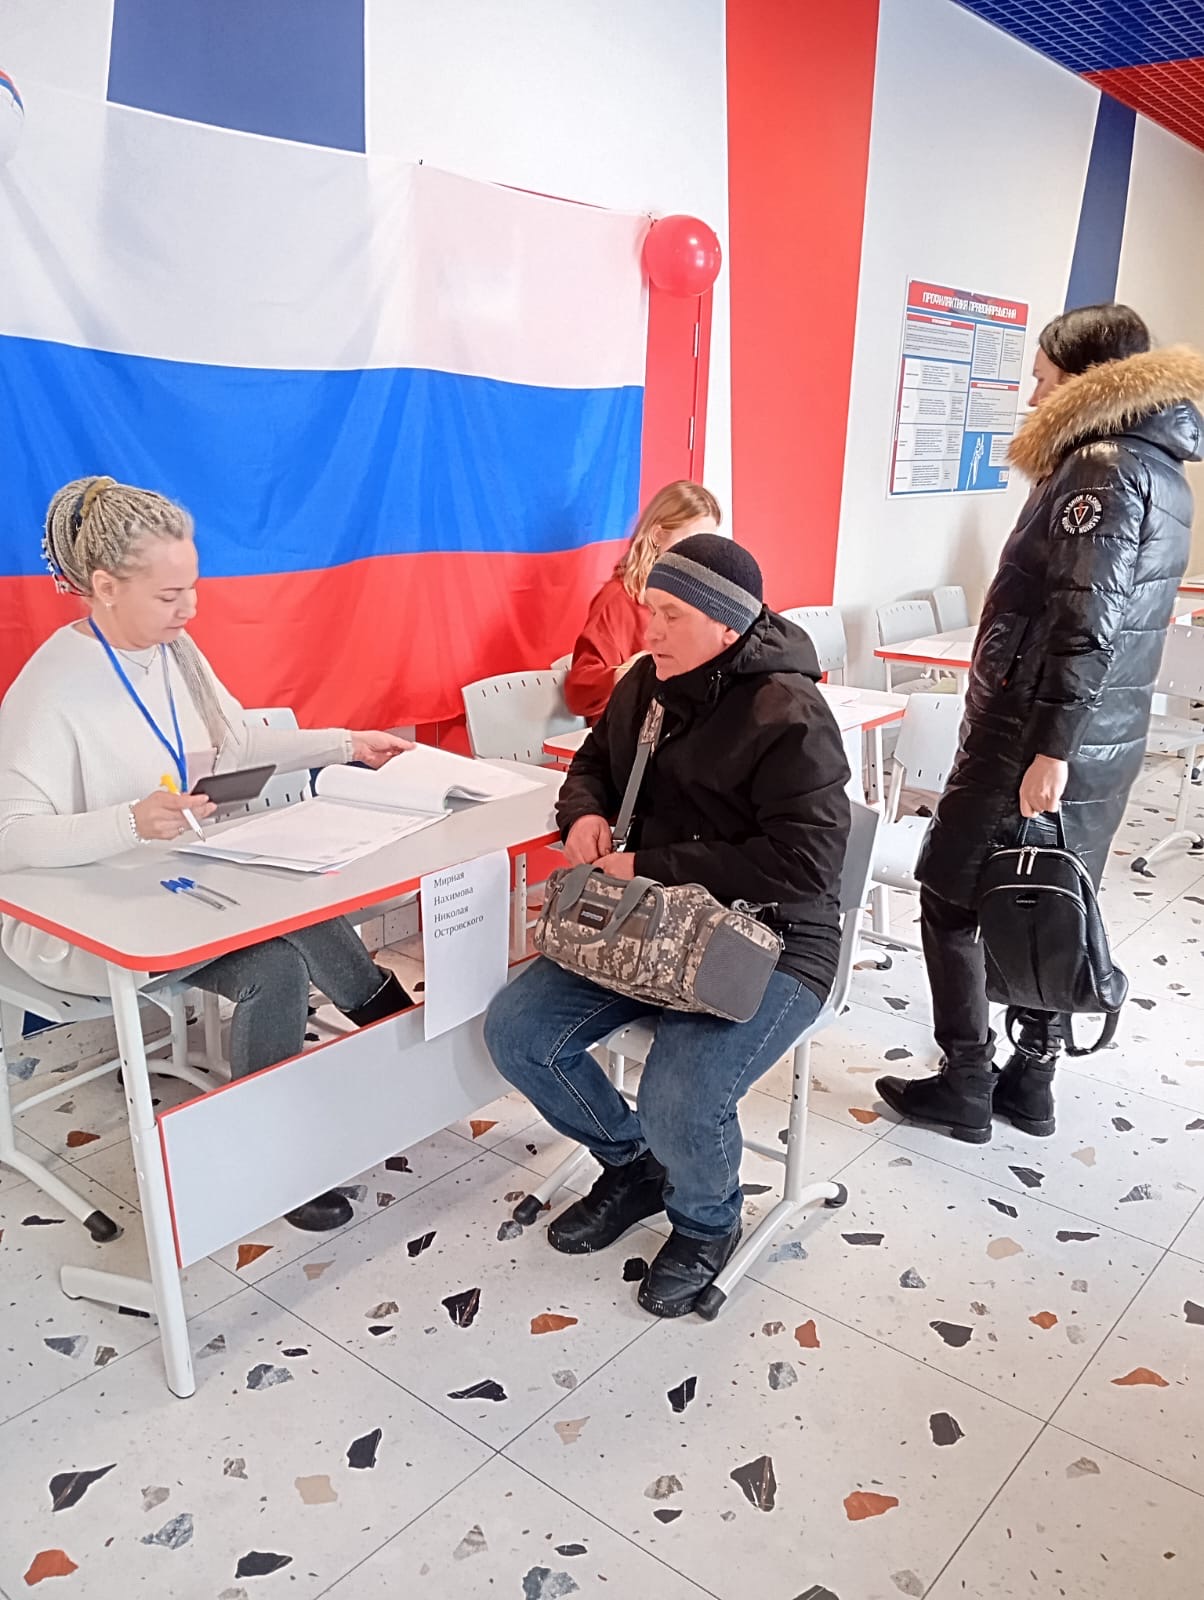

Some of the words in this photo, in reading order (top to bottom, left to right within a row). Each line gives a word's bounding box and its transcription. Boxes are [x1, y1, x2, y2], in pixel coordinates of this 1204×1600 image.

[433, 872, 465, 888] Мирная
[433, 887, 474, 906] Нахимова
[434, 906, 469, 923] Николая
[434, 915, 484, 939] Островского
